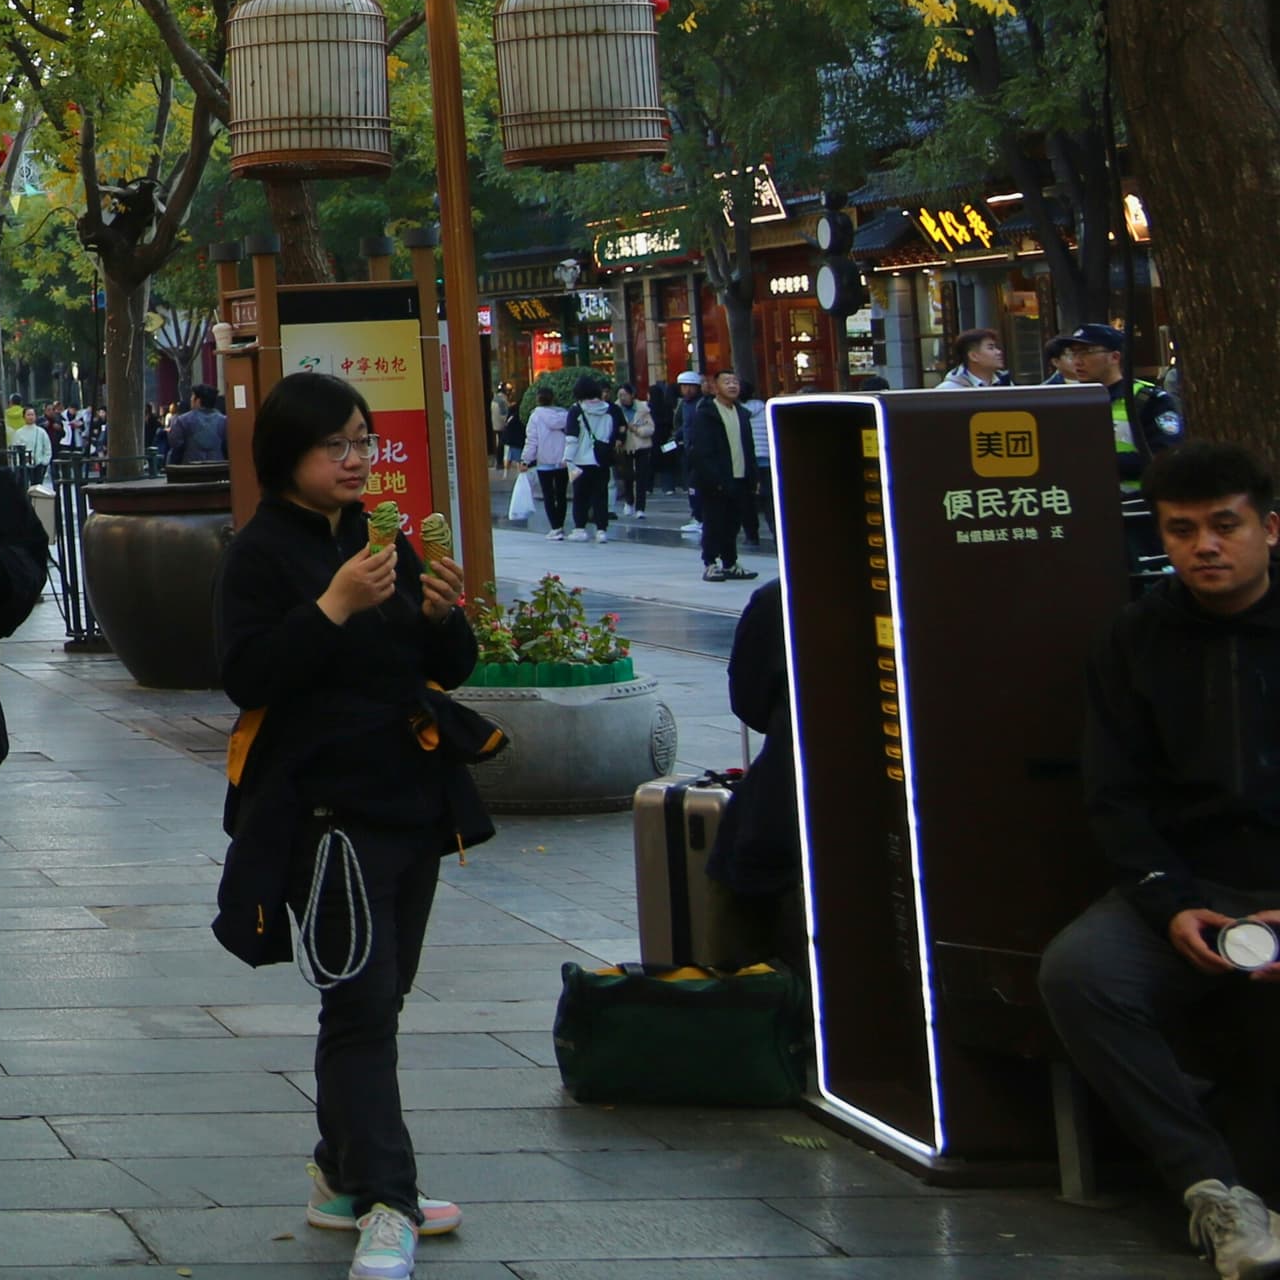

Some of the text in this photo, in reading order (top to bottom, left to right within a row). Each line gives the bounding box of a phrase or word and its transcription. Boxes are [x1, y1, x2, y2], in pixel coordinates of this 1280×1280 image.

[975, 431, 1033, 459] 美团
[943, 485, 1072, 520] 便民充电
